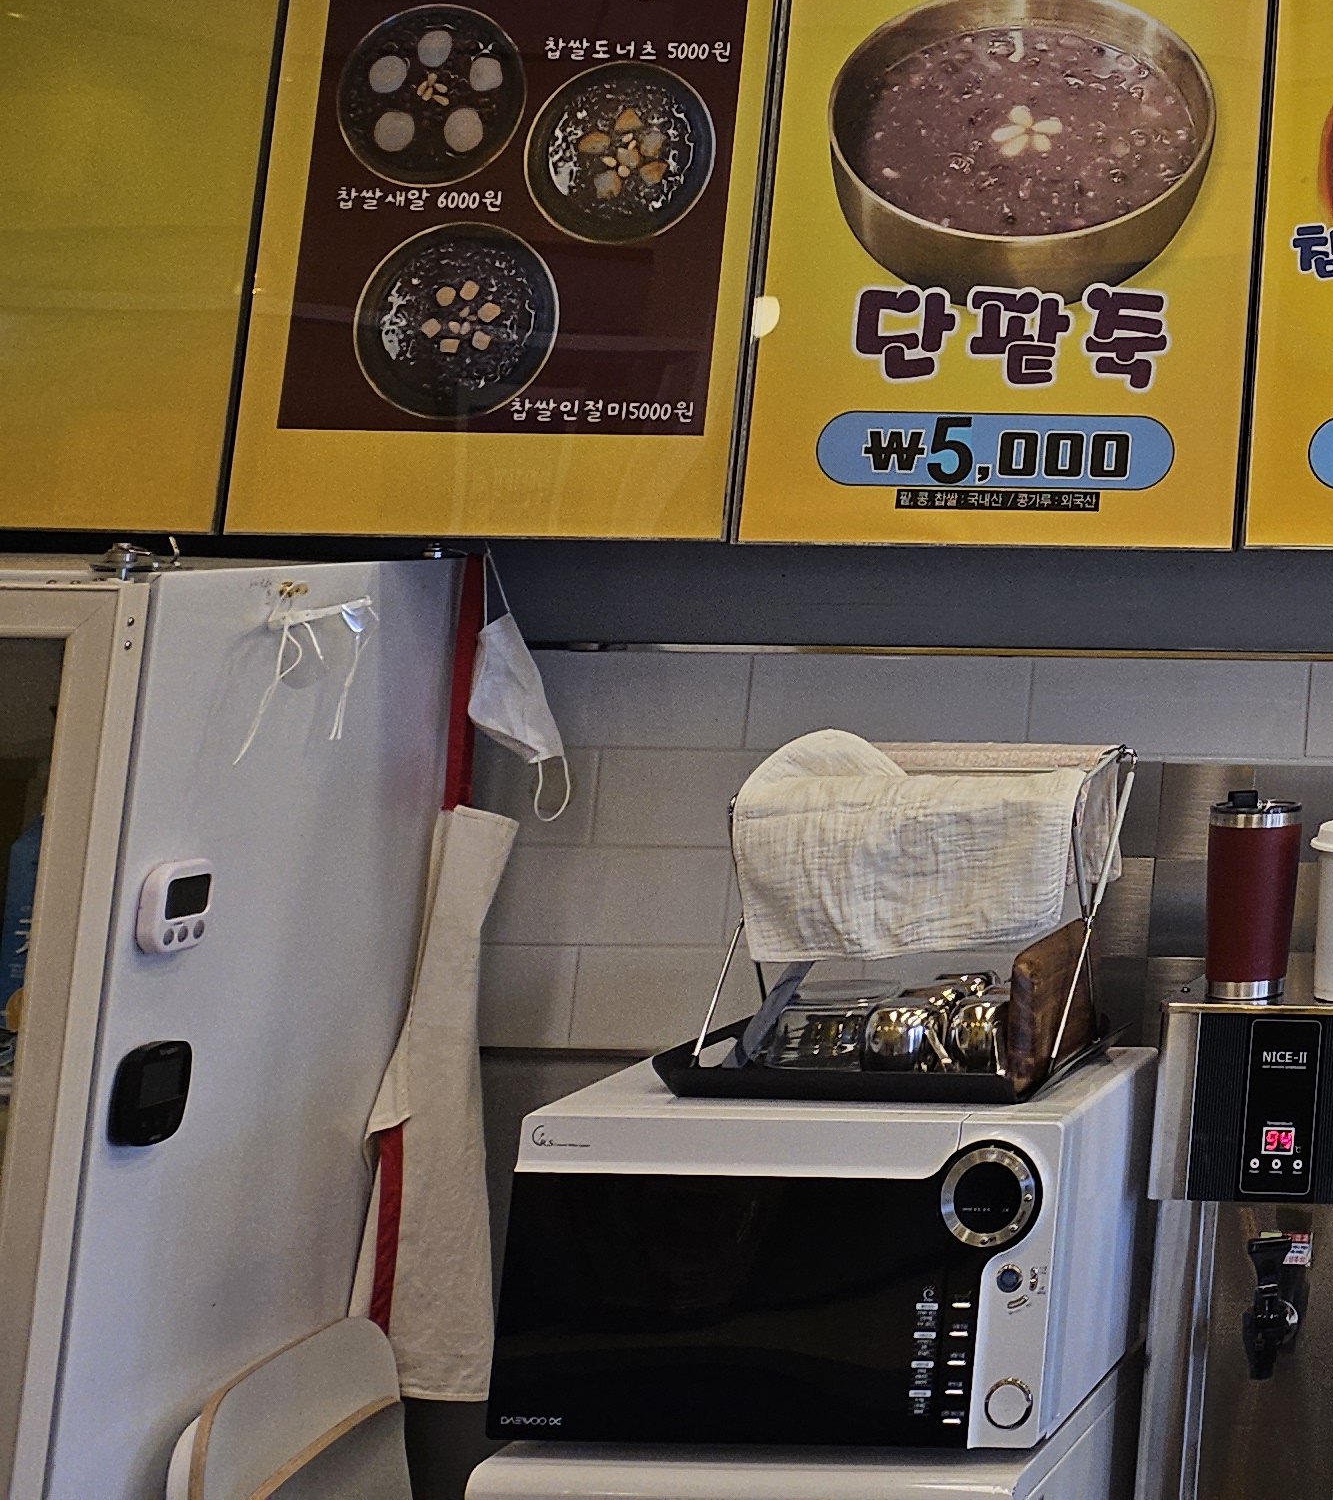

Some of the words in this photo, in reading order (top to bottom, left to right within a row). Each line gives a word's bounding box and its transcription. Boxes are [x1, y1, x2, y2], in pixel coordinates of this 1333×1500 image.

[545, 36, 657, 60] 찹쌀도너츠
[667, 41, 731, 63] 5000원
[337, 186, 431, 211] 찹쌀새알
[437, 190, 502, 212] 6000원
[853, 285, 1169, 391] 단팥죽
[1266, 1131, 1292, 1150] 94
[500, 1416, 547, 1425] DAEWOO
